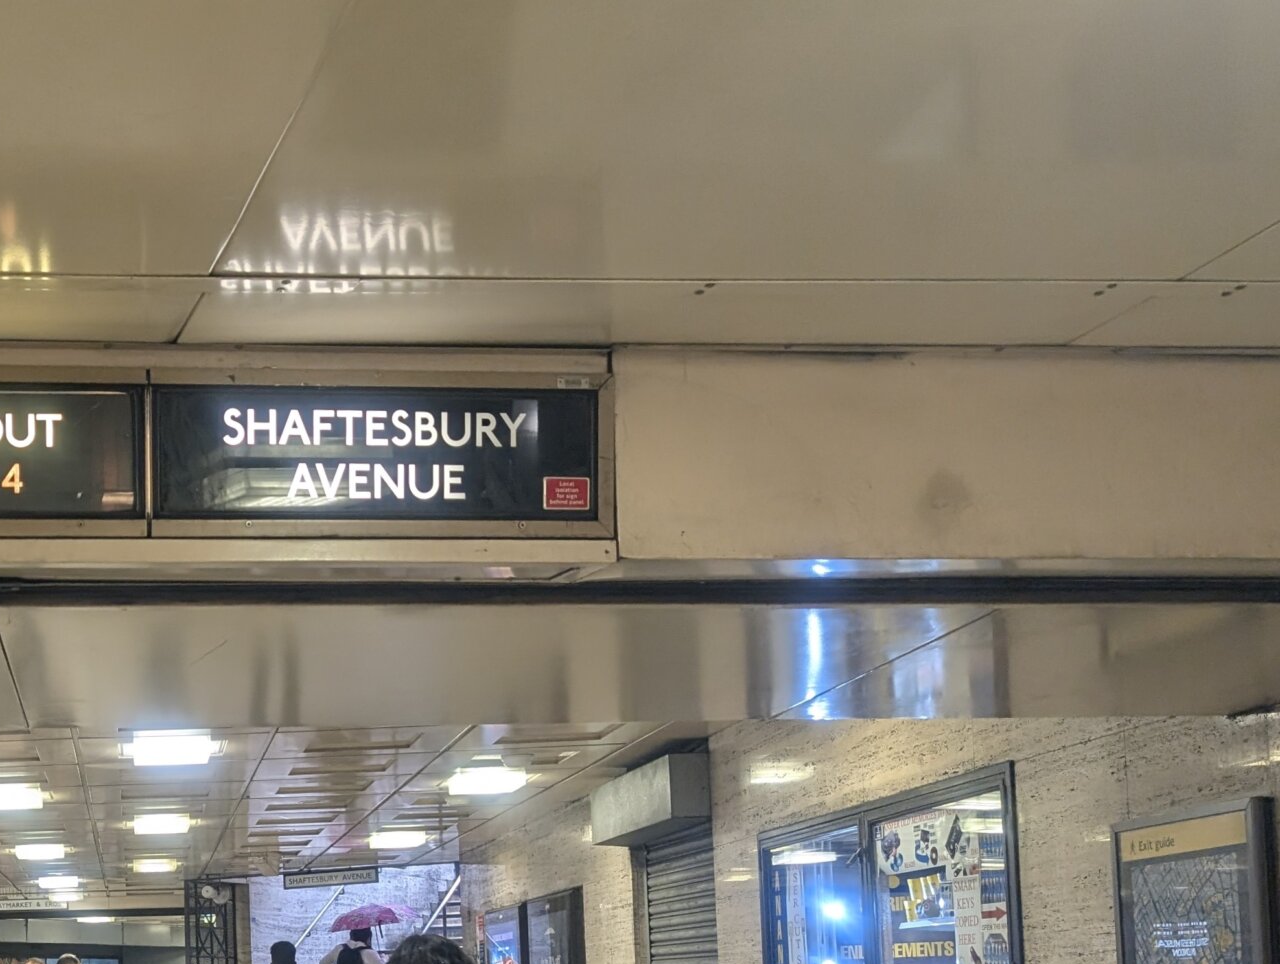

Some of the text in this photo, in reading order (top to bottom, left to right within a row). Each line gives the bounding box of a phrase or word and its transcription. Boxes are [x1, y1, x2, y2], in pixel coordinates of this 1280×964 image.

[223, 407, 527, 448] SHAFTESBURY
[1, 463, 23, 494] 4
[287, 462, 466, 500] AVENUE
[1138, 837, 1175, 851] Exit guide
[288, 872, 373, 885] SHAFTESBURY AVENUE
[953, 878, 976, 892] SMART
[956, 897, 975, 910] KEYS
[959, 933, 976, 945] HERE
